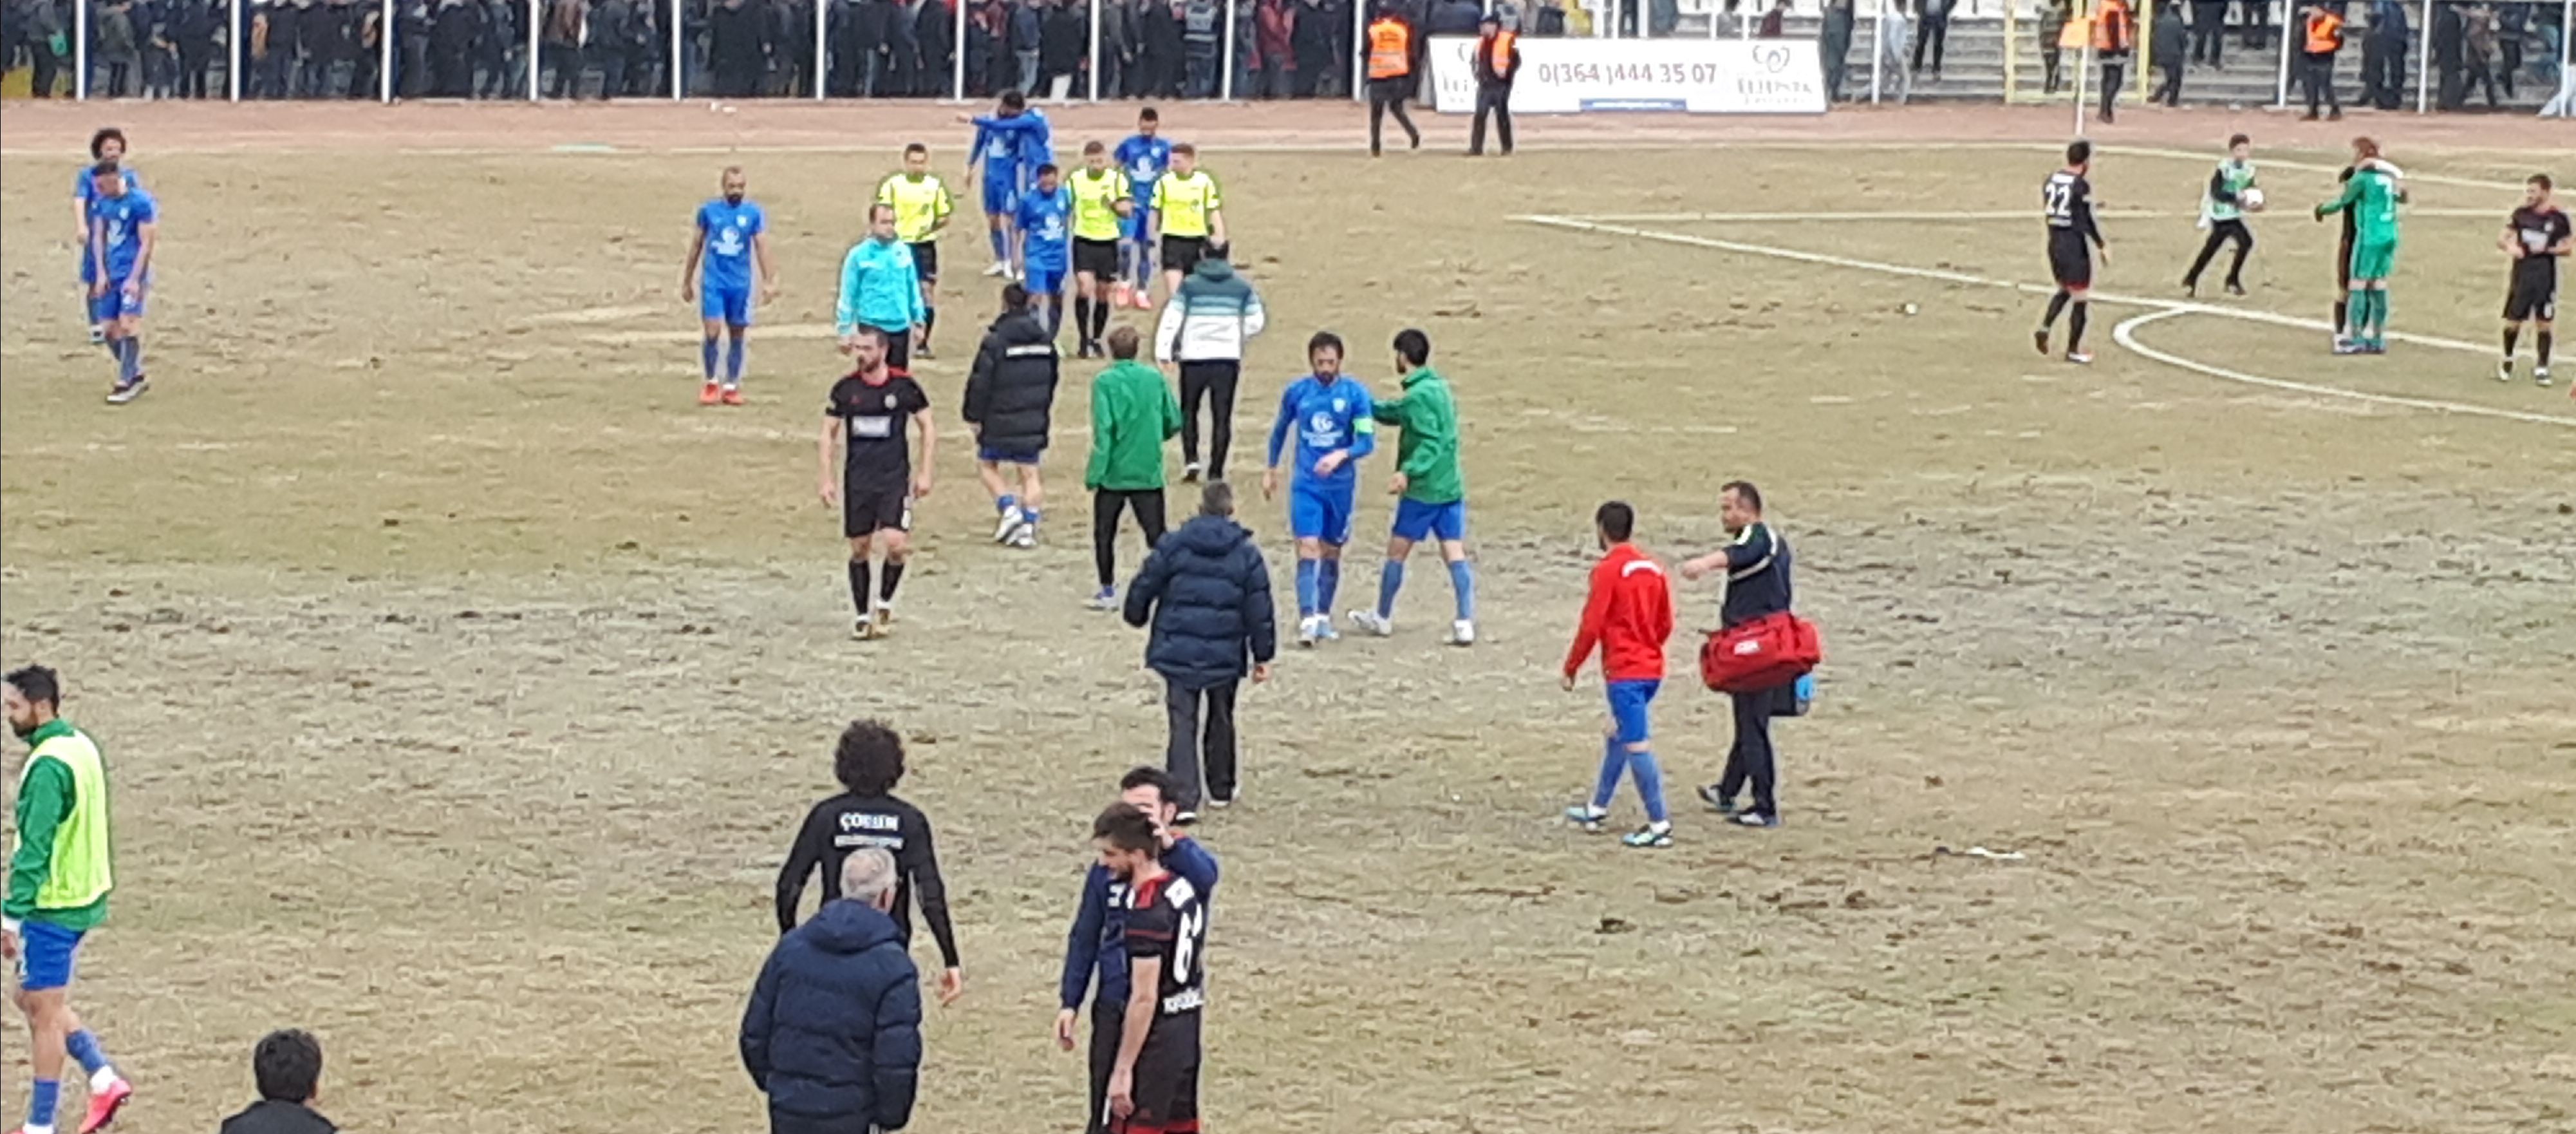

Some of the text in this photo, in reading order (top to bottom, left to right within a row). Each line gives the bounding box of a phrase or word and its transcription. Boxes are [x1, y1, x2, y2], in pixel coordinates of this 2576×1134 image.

[1659, 63, 1685, 84] 35
[1692, 63, 1716, 84] 07
[2046, 183, 2071, 215] 22
